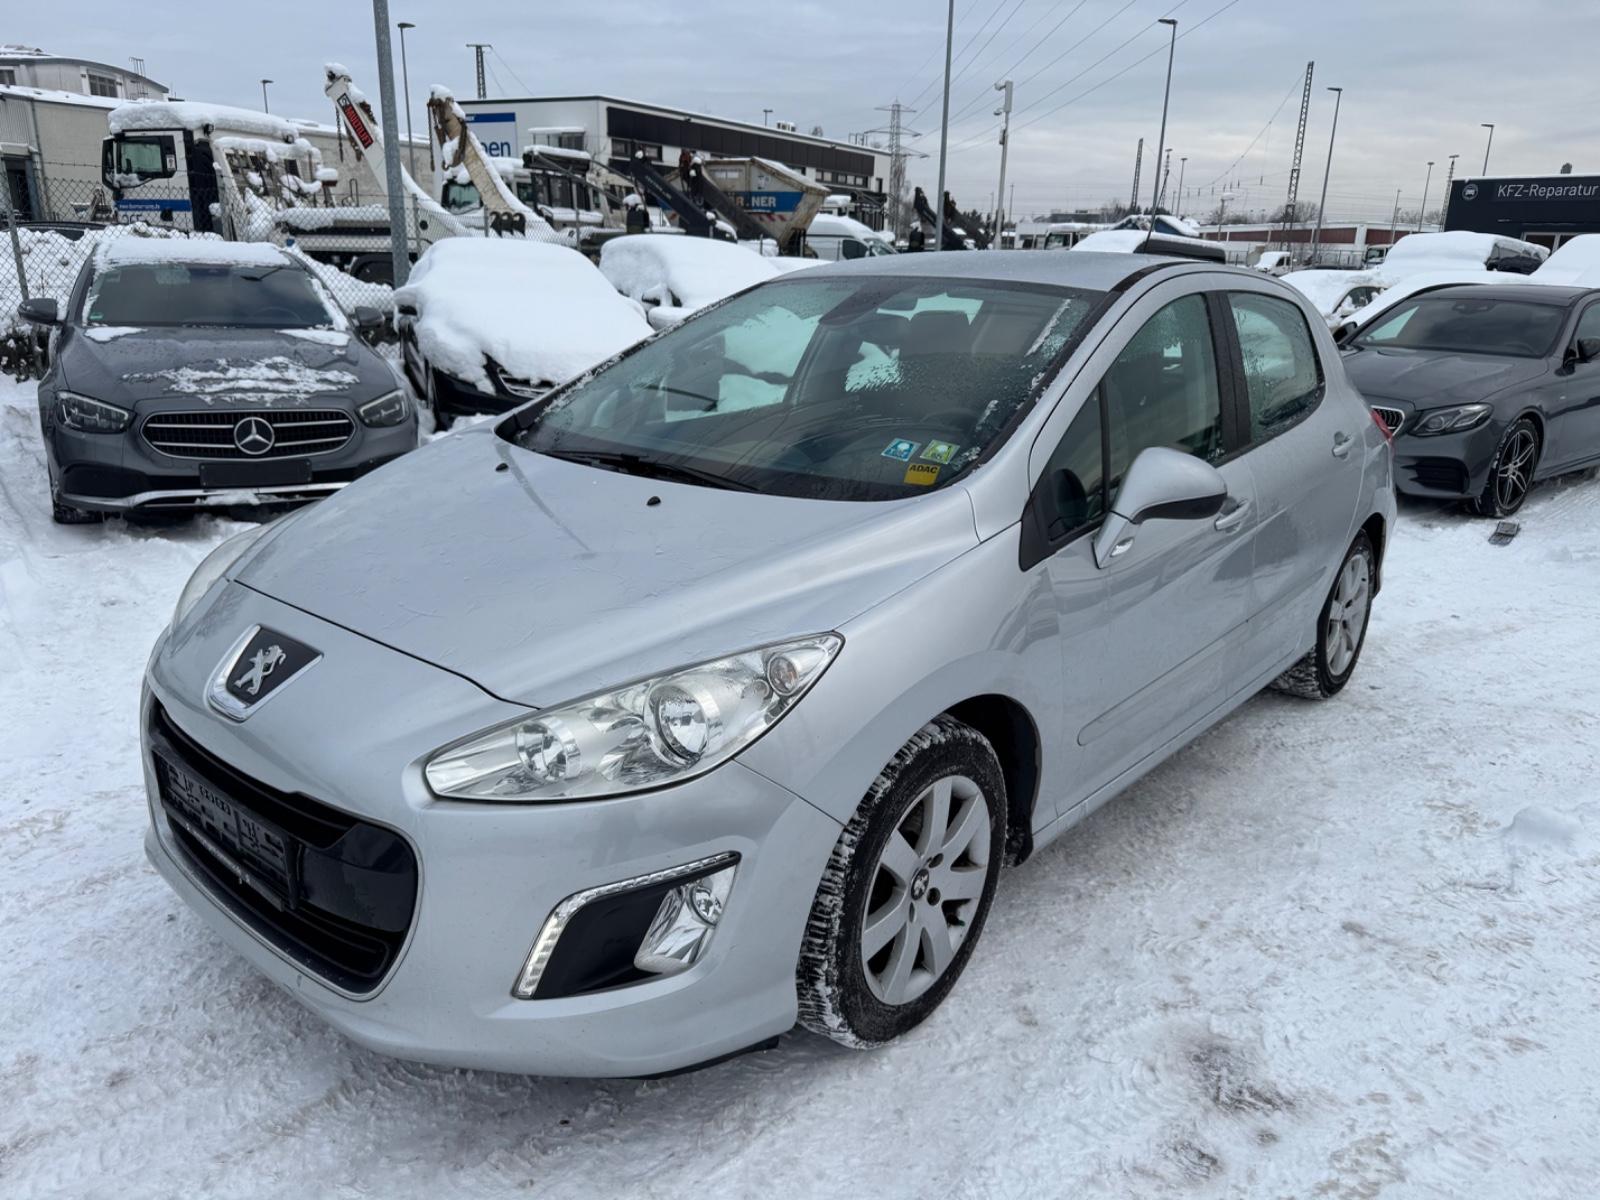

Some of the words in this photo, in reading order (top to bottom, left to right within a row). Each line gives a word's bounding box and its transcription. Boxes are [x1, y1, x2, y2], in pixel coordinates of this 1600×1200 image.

[344, 104, 373, 147] MULTILIFT
[1497, 184, 1599, 199] KFZ-Reparatur
[908, 464, 938, 474] ADAC
